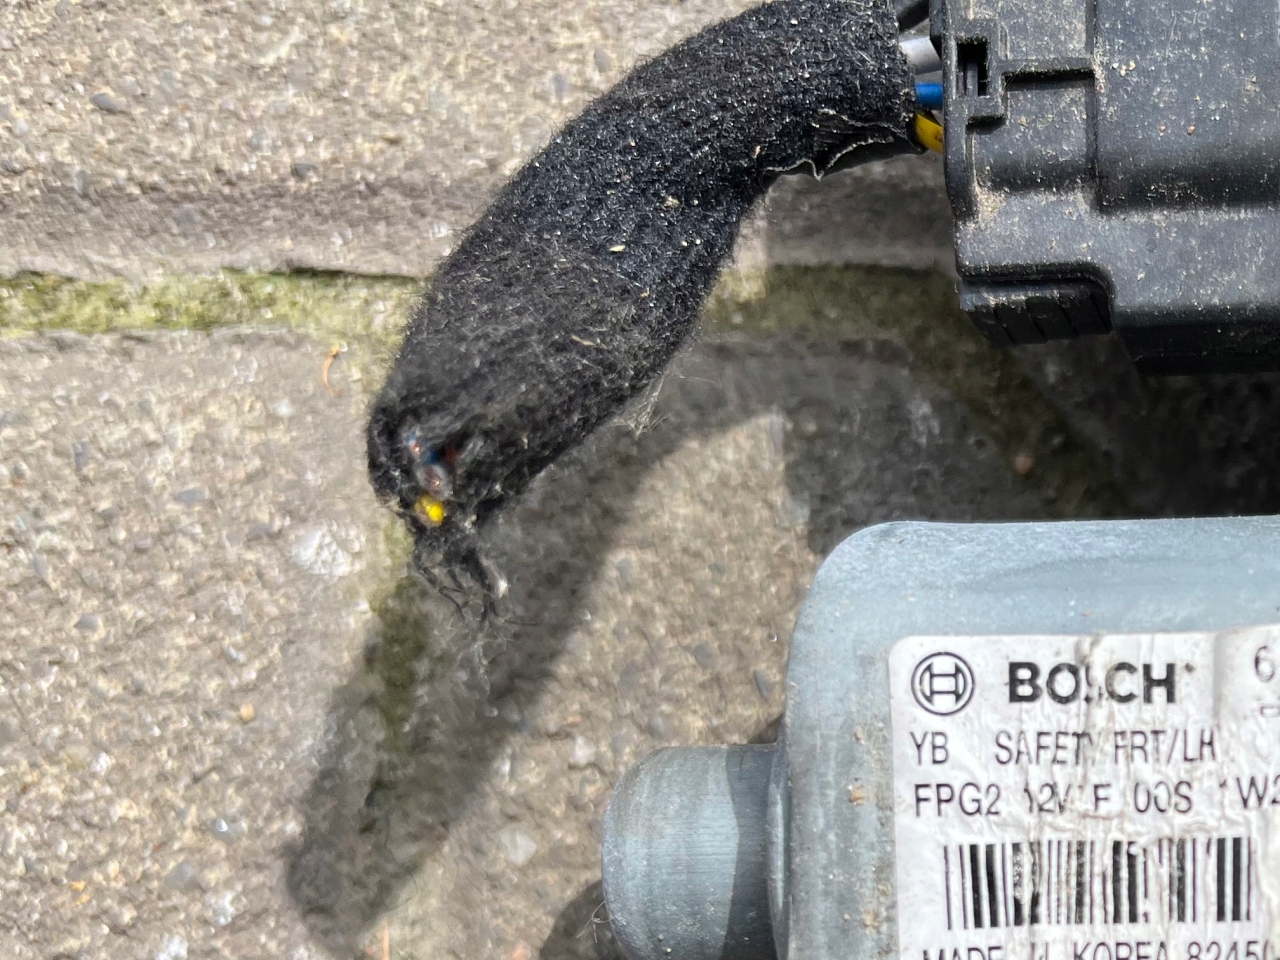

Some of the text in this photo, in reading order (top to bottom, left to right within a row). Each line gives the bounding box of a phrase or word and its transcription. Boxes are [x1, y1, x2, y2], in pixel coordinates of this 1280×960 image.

[909, 731, 950, 766] YB
[1113, 727, 1217, 766] FRT/LH
[914, 781, 1002, 818] FPG2
